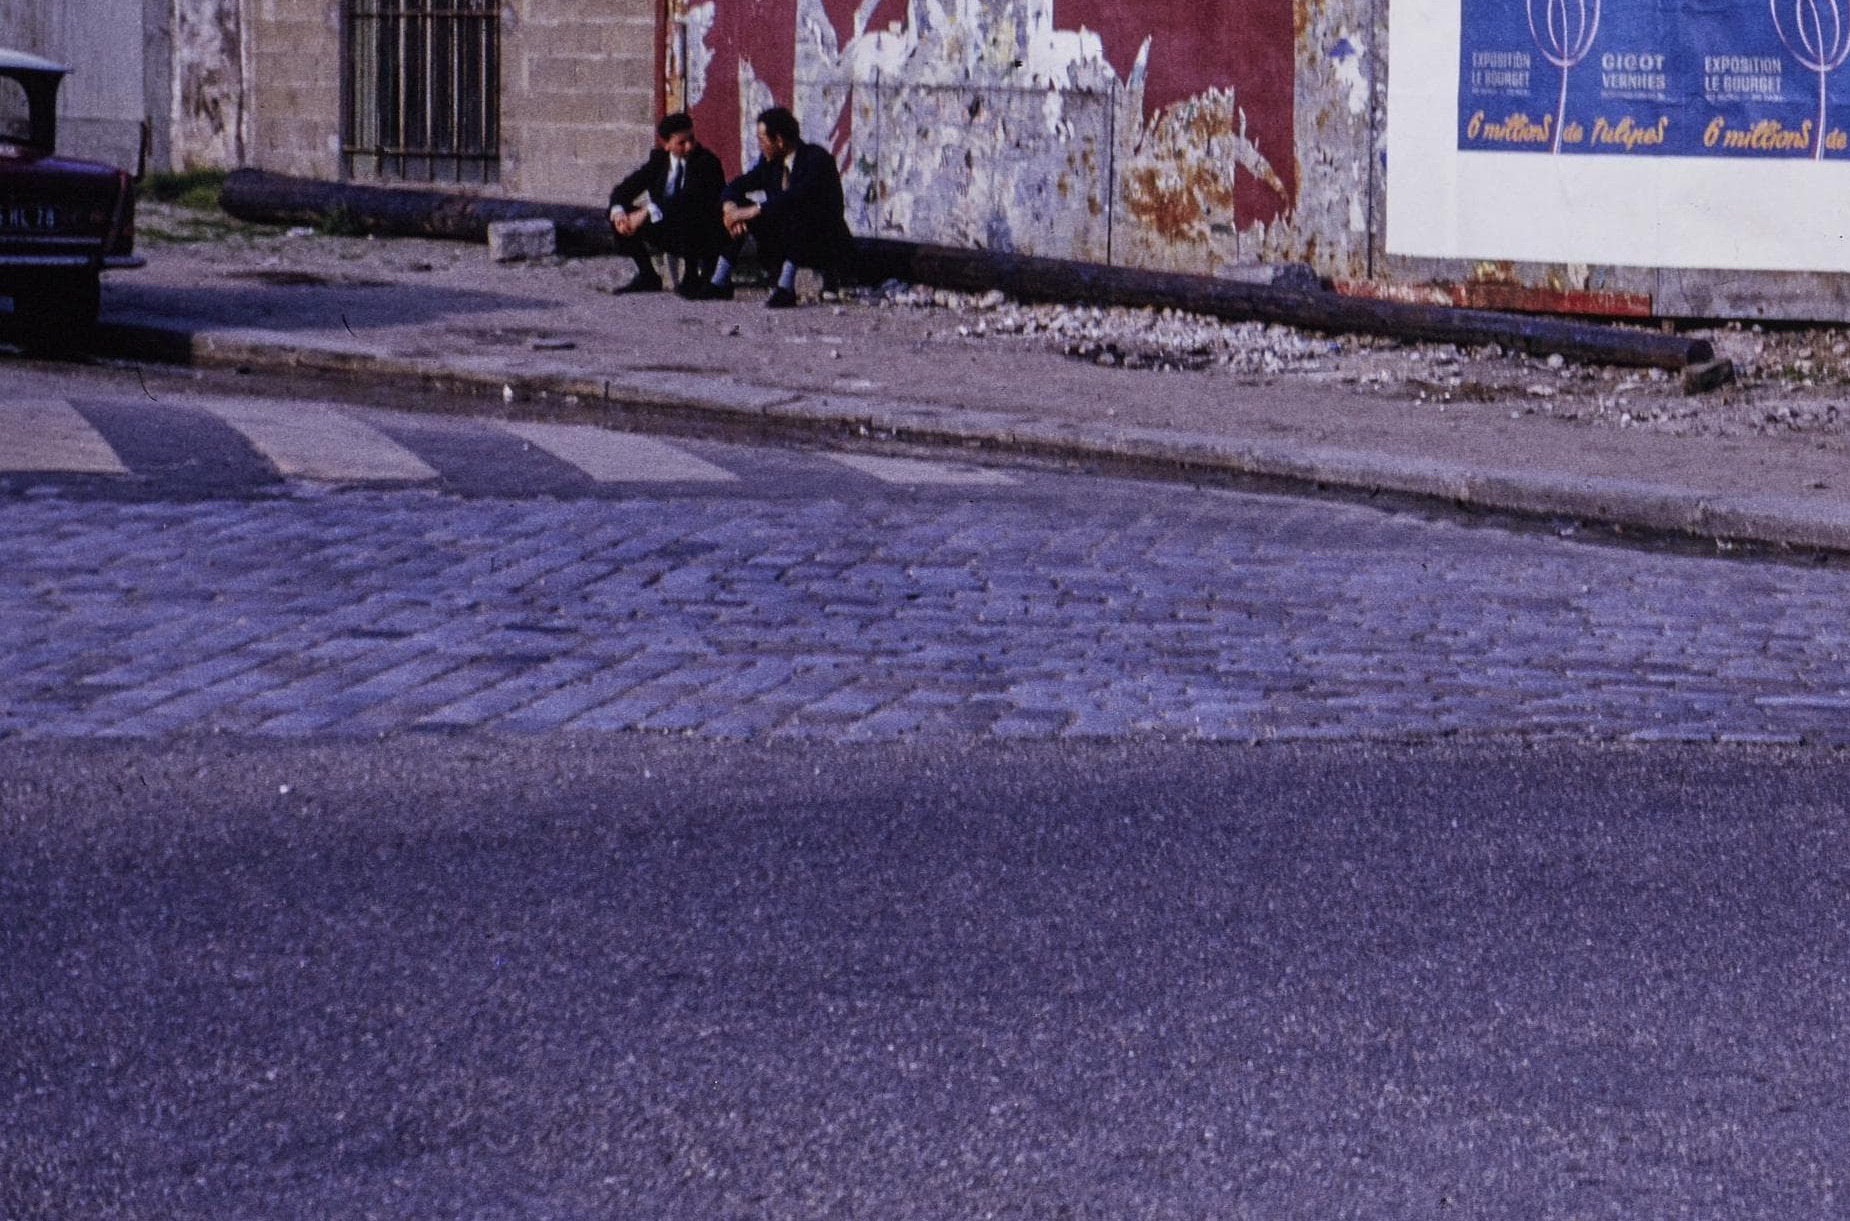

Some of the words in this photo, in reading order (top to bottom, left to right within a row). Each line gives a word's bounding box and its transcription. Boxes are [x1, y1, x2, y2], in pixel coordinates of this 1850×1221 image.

[1601, 52, 1665, 71] GIGOT
[1704, 55, 1781, 75] EXPOSITION
[1705, 76, 1717, 91] LE
[1467, 109, 1484, 140] 6
[1484, 113, 1552, 142] millions
[1563, 121, 1583, 143] de
[1703, 115, 1724, 147] 6
[1724, 118, 1812, 149] millions
[1825, 127, 1847, 150] de
